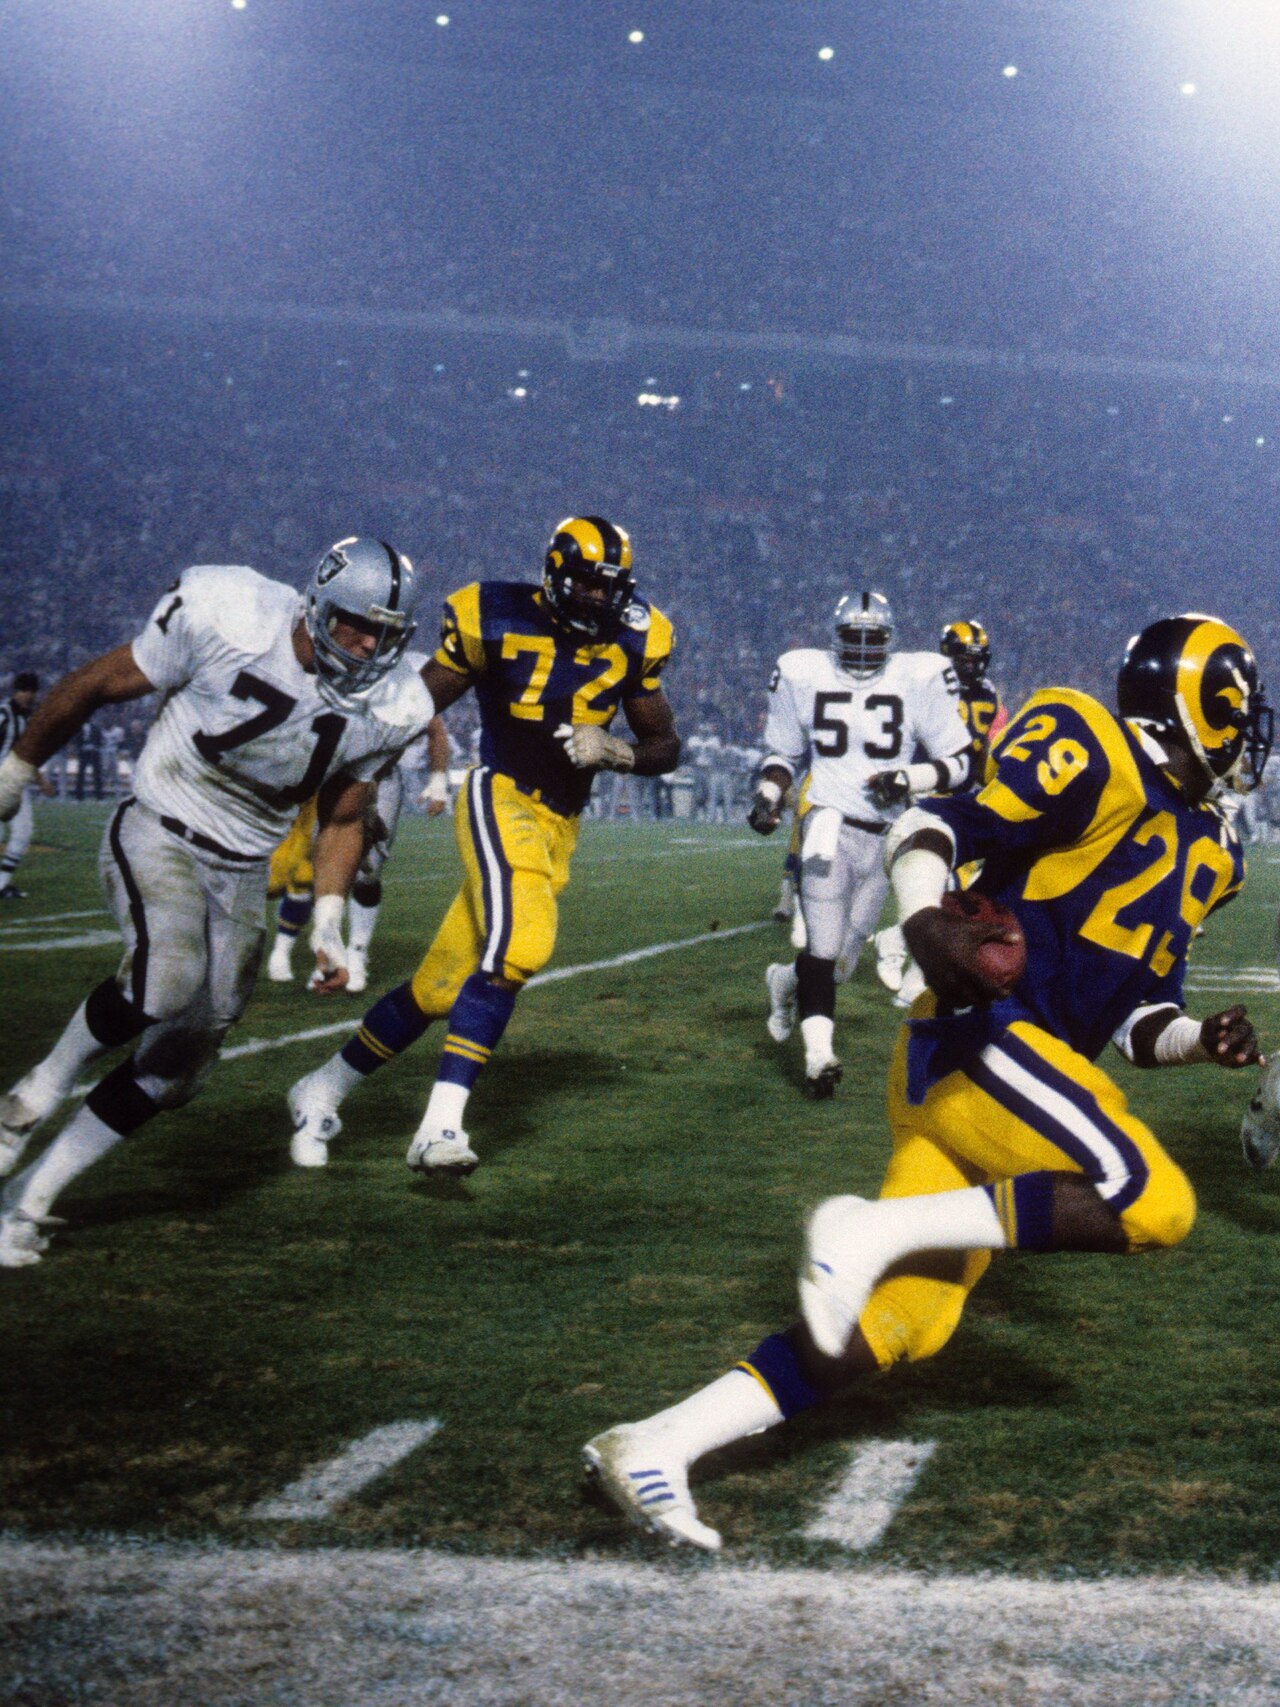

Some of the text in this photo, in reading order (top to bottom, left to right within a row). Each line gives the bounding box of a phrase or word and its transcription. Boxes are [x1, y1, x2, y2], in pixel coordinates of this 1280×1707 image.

[502, 632, 628, 725] 72
[768, 664, 781, 693] 3
[192, 671, 347, 804] 71
[813, 692, 904, 760] 53
[1001, 714, 1089, 796] 29
[1078, 810, 1236, 978] 29
